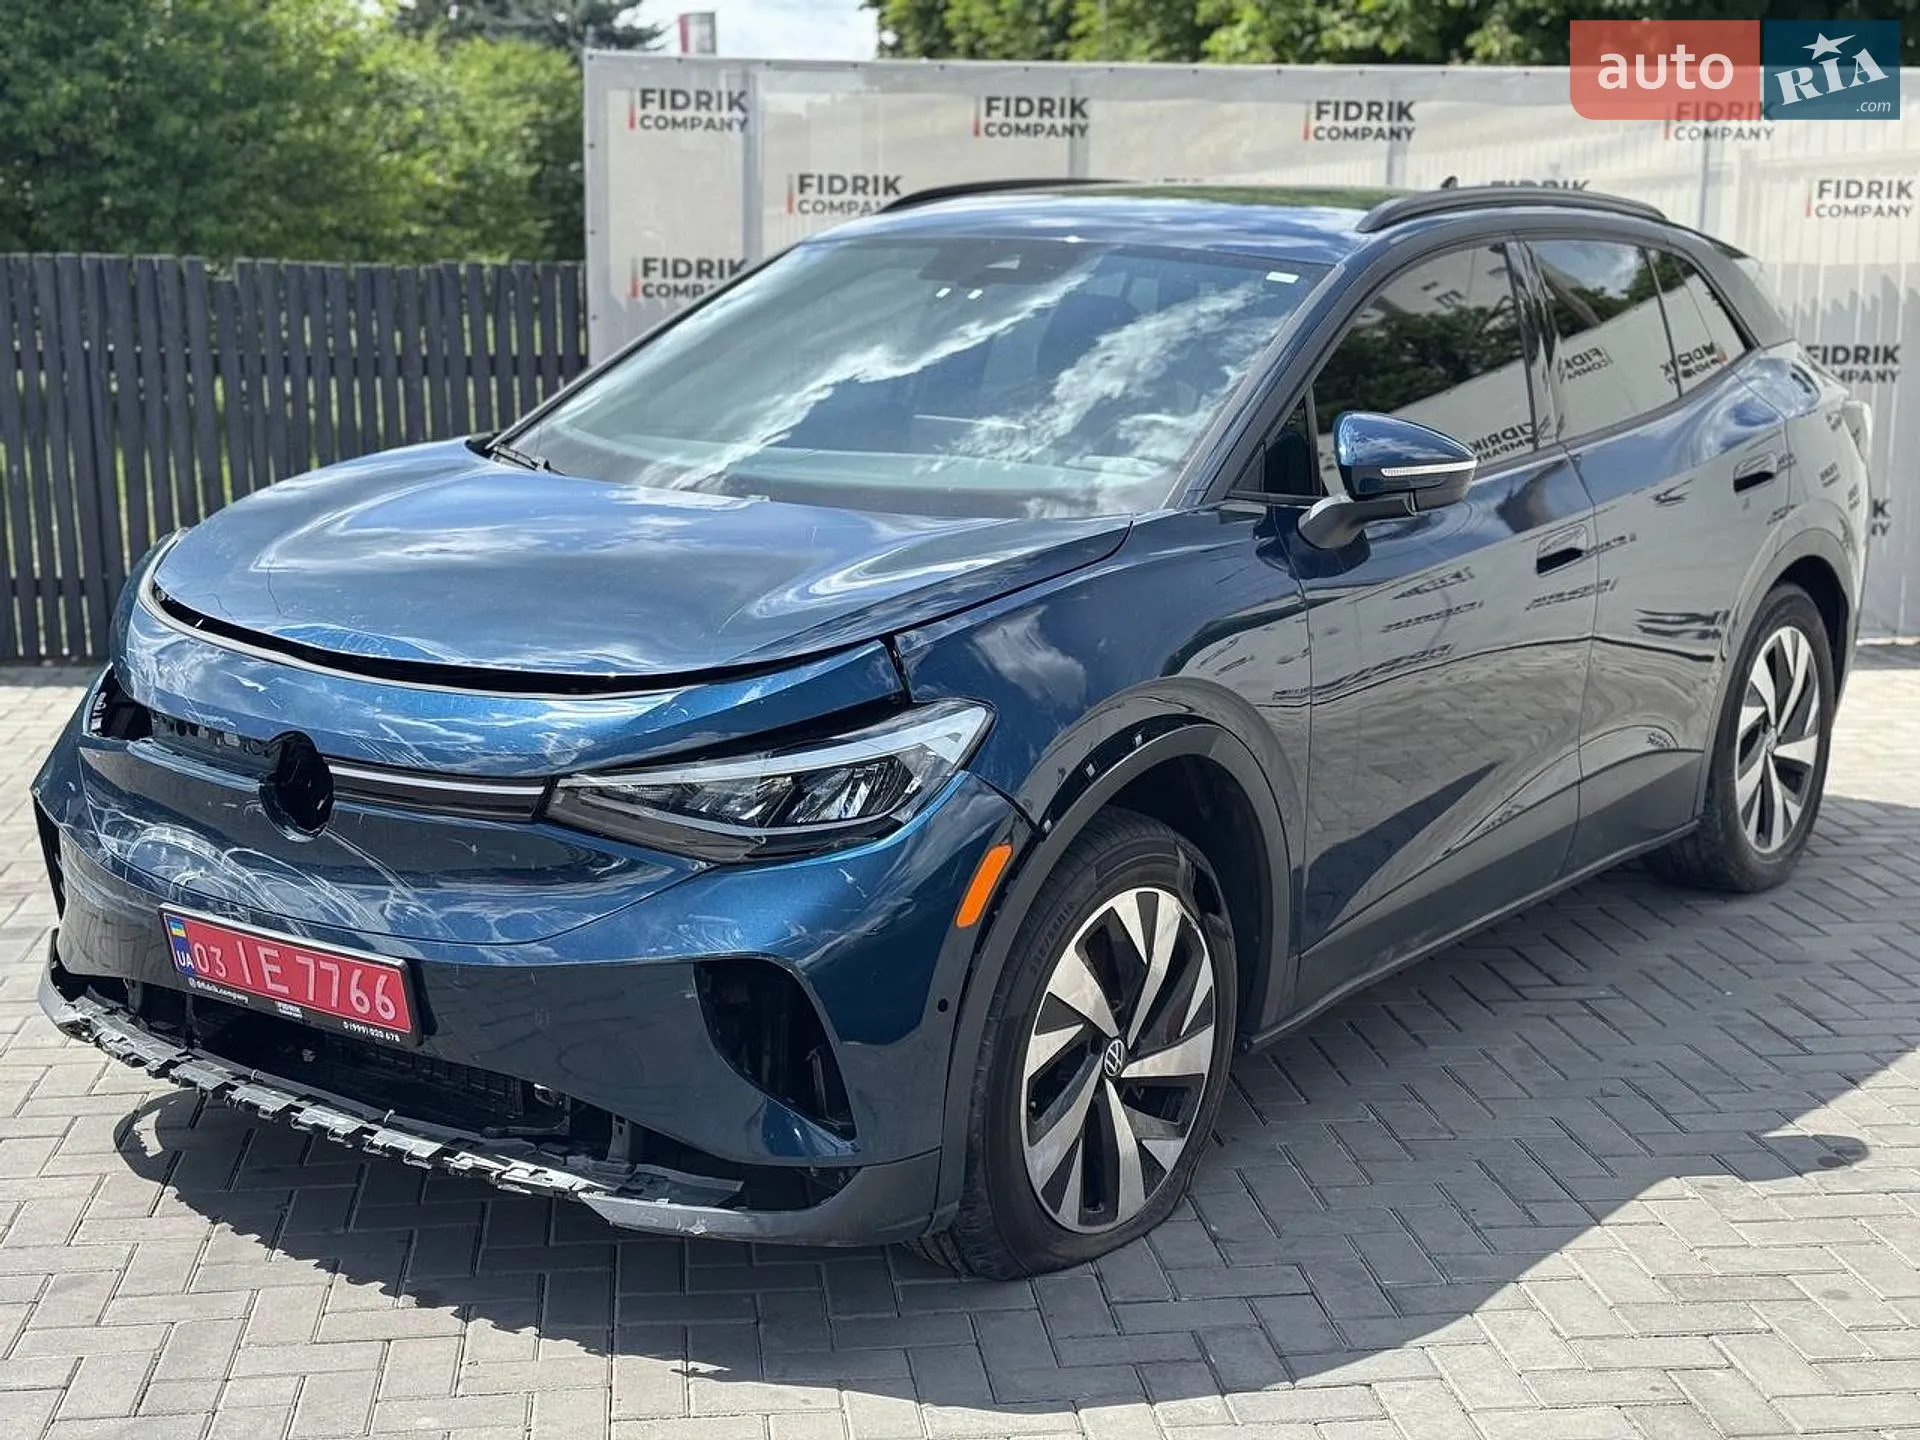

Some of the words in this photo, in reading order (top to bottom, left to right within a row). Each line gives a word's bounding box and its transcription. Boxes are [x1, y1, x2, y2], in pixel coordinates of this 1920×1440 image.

[640, 88, 748, 112] FIDRIK
[984, 96, 1088, 118] FIDRIK
[1315, 100, 1415, 121] FIDRIK
[639, 114, 748, 132] COMPANY
[984, 121, 1088, 138] COMPANY
[1313, 125, 1415, 141] COMPANY
[1674, 126, 1775, 141] COMPANY
[798, 174, 902, 196] FIDRIK
[1818, 179, 1914, 200] FIDRIK
[798, 199, 881, 215] COMPA
[1815, 204, 1914, 219] COMPANY
[642, 283, 716, 298] COMP
[177, 950, 195, 969] UA
[194, 942, 227, 979] 03
